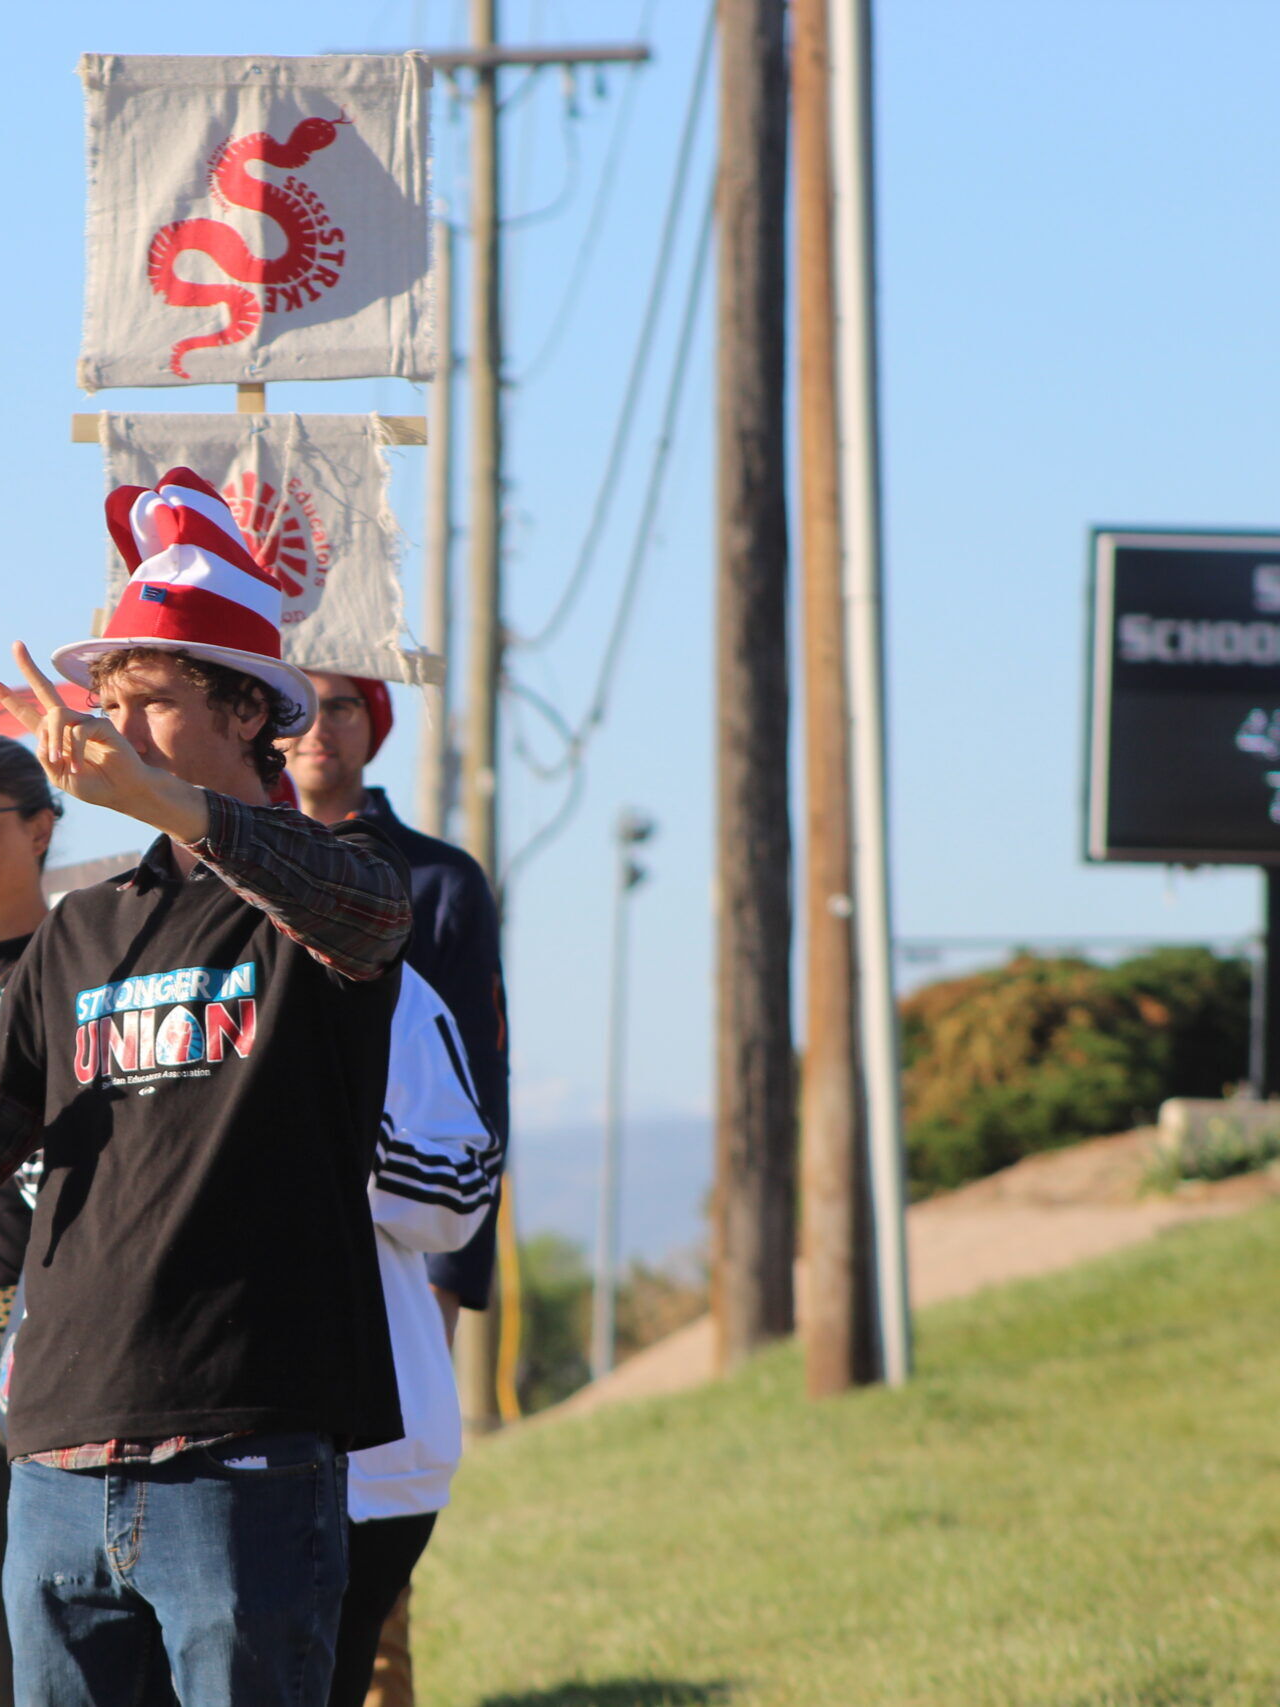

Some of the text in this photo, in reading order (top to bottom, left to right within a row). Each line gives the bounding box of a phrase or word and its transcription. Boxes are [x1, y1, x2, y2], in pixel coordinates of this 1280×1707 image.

[1120, 614, 1280, 665] SCHOO
[78, 966, 251, 1021] STRONGER IN
